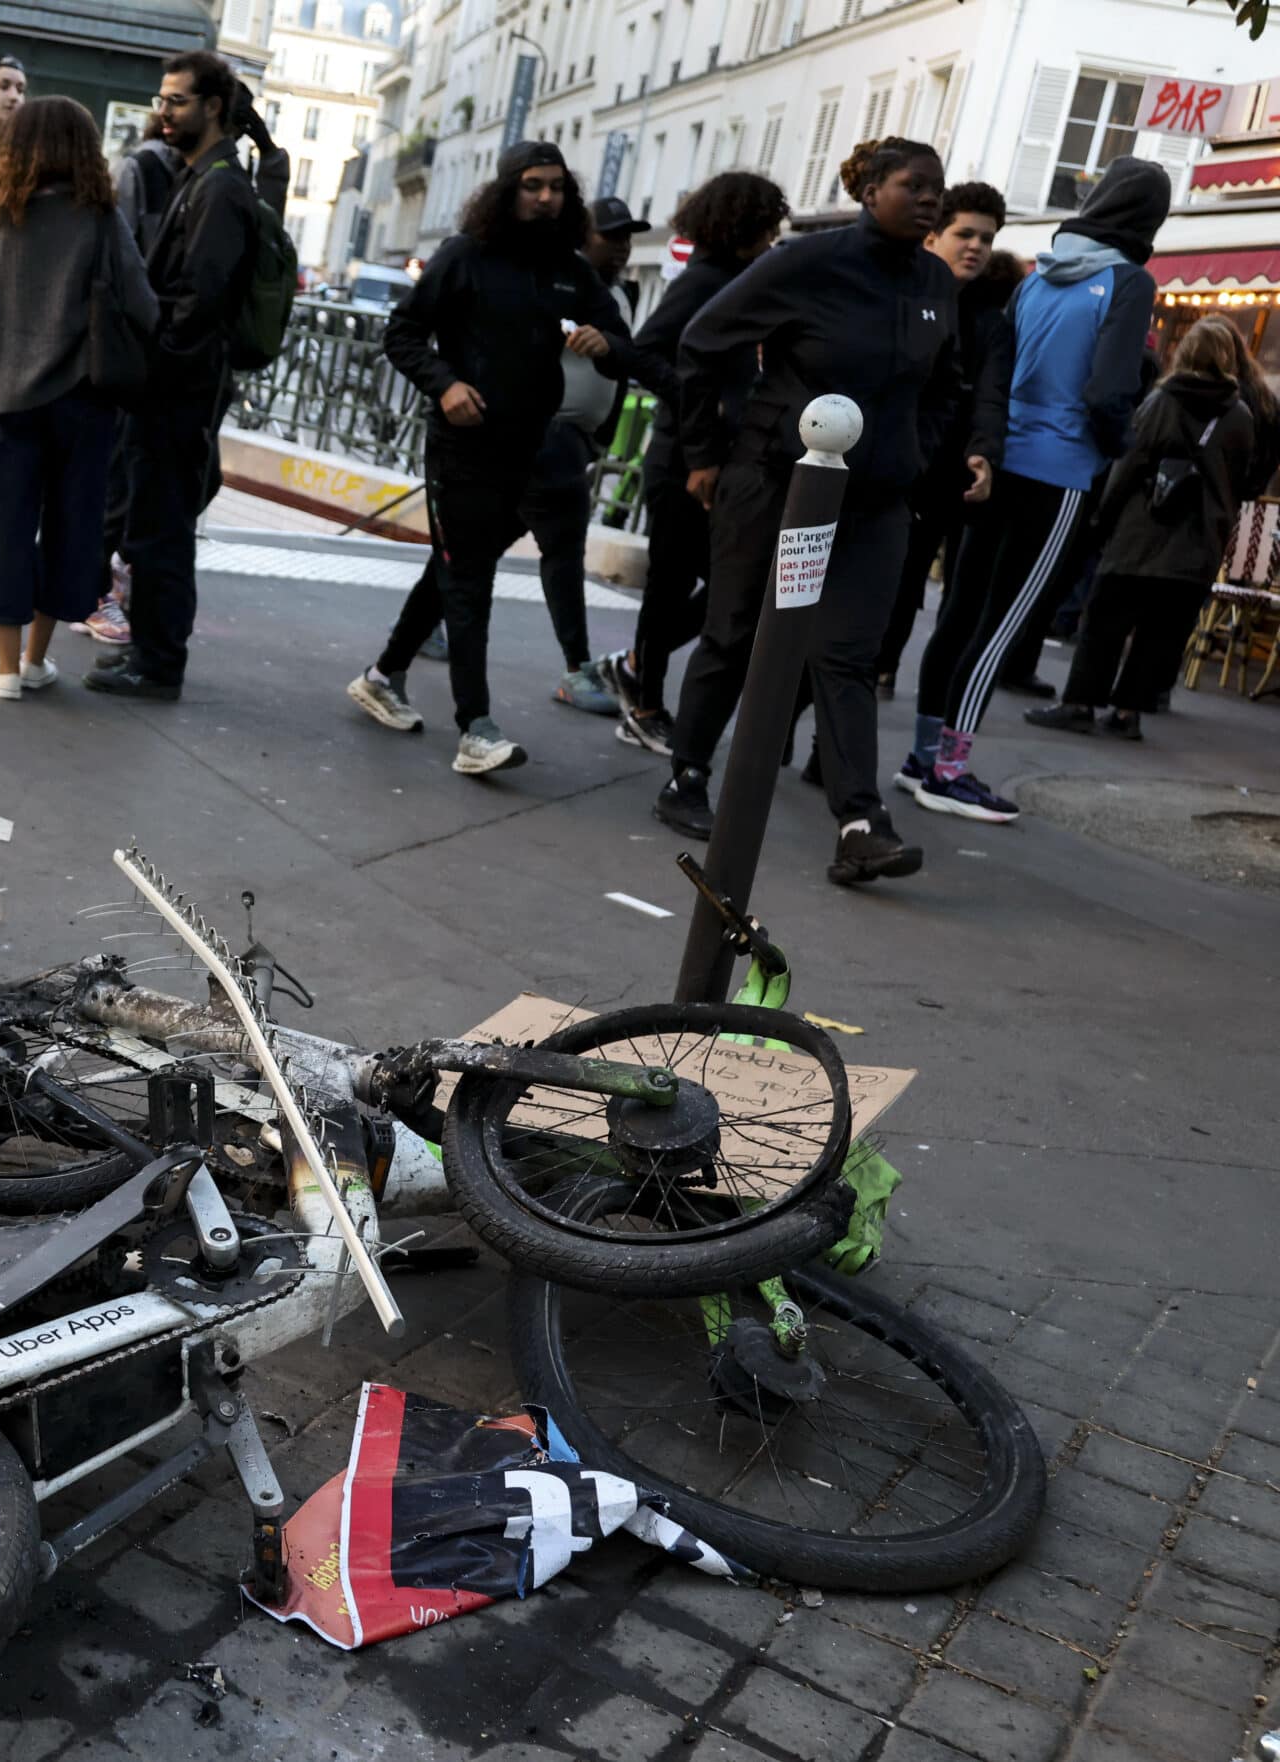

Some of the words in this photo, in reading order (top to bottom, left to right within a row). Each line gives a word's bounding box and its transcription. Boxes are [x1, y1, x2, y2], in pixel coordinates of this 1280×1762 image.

[1147, 81, 1222, 133] BAR
[781, 534, 795, 544] De
[780, 546, 806, 558] pour
[808, 543, 823, 554] les
[780, 561, 799, 572] pas
[801, 558, 825, 570] pour
[780, 571, 795, 582] les
[780, 585, 794, 594] ou
[68, 1303, 136, 1336] Apps
